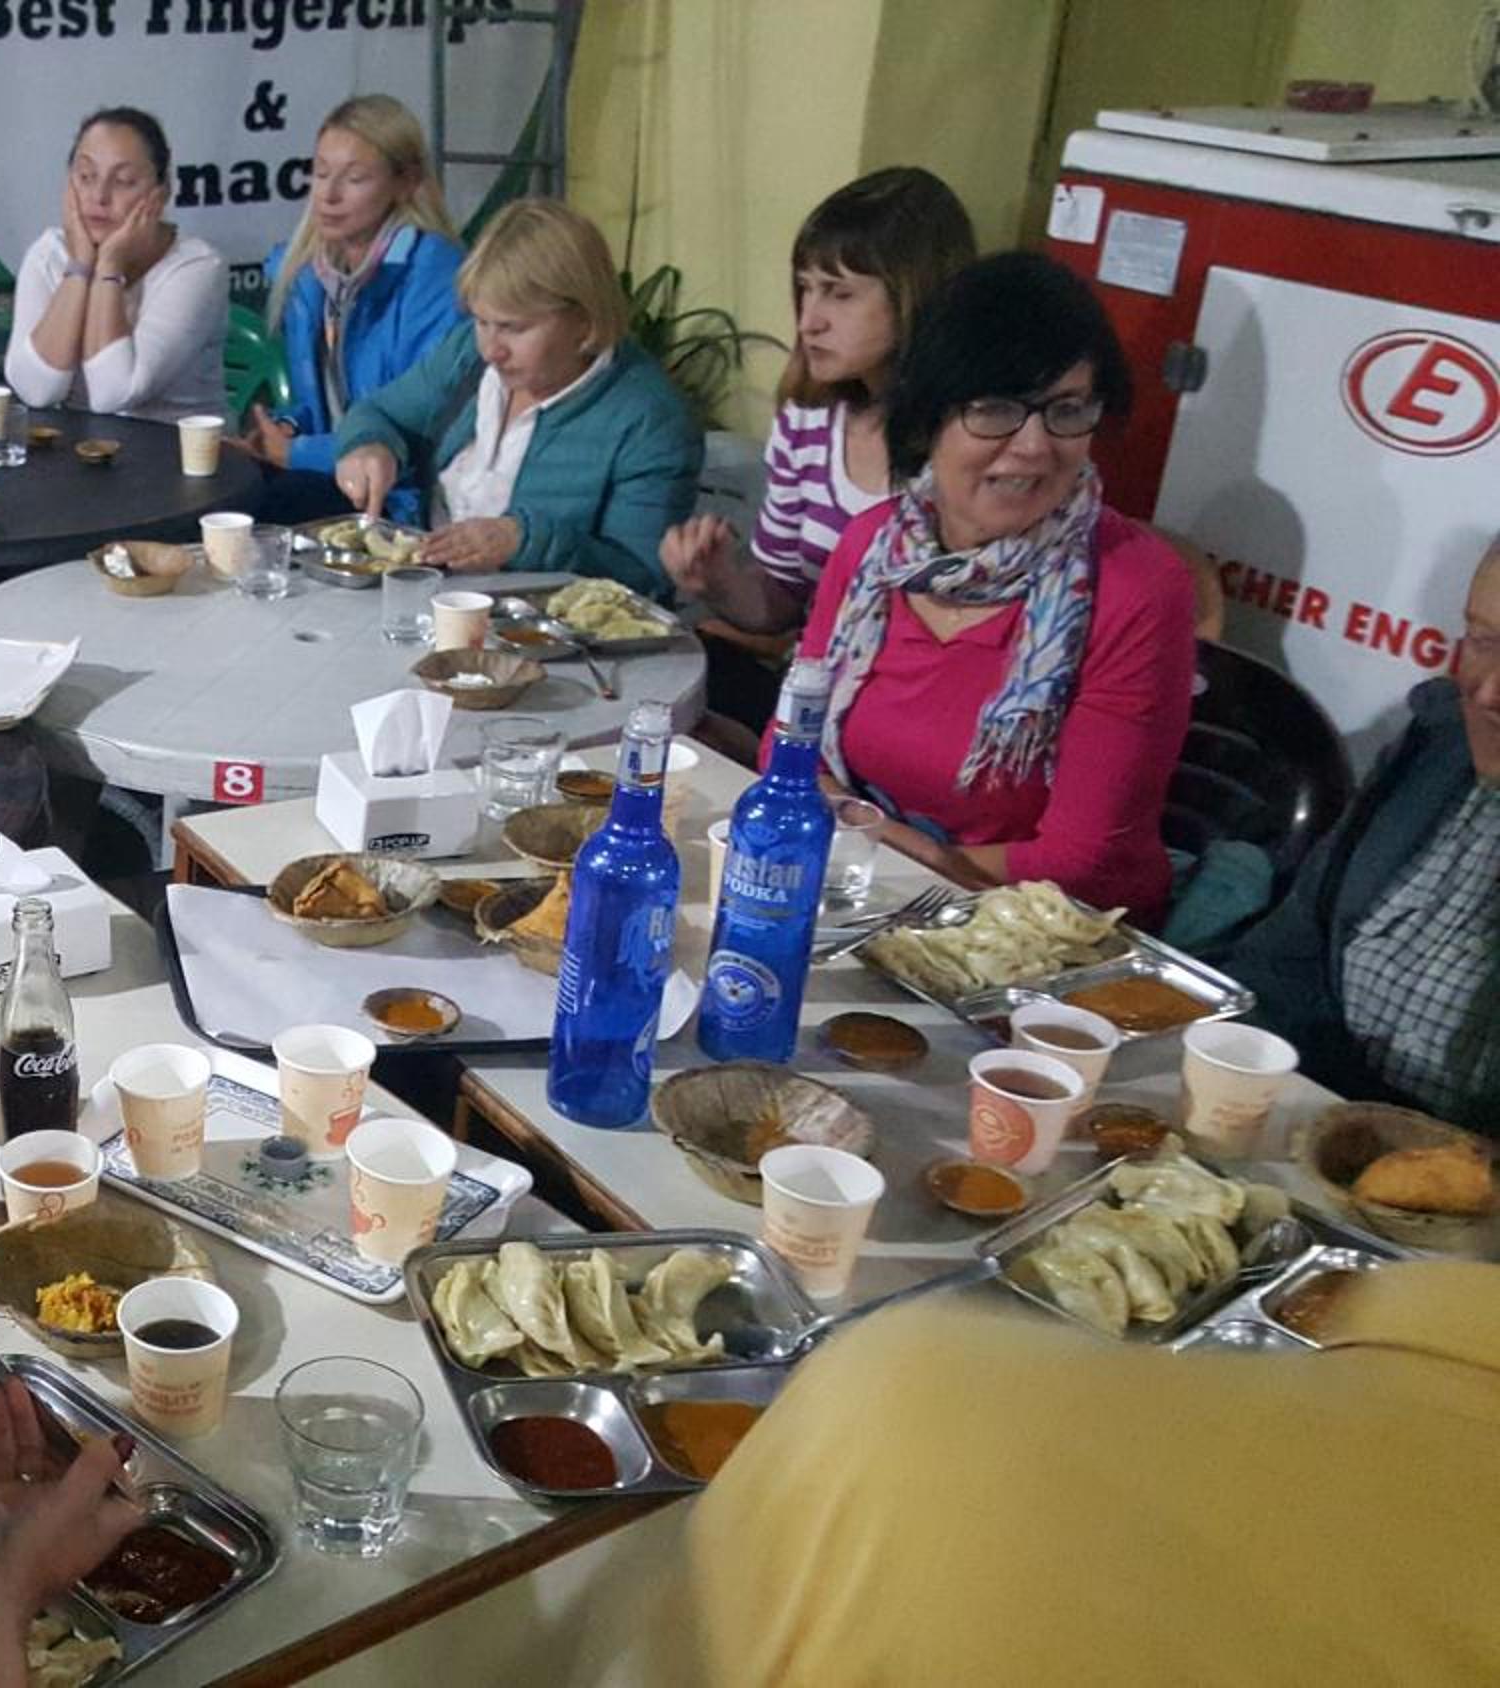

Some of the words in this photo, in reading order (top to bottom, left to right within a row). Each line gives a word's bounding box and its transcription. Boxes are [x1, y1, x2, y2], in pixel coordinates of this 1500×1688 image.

[244, 79, 288, 132] &
[174, 156, 314, 208] nac
[1208, 553, 1329, 631] CHER
[223, 765, 254, 797] 8
